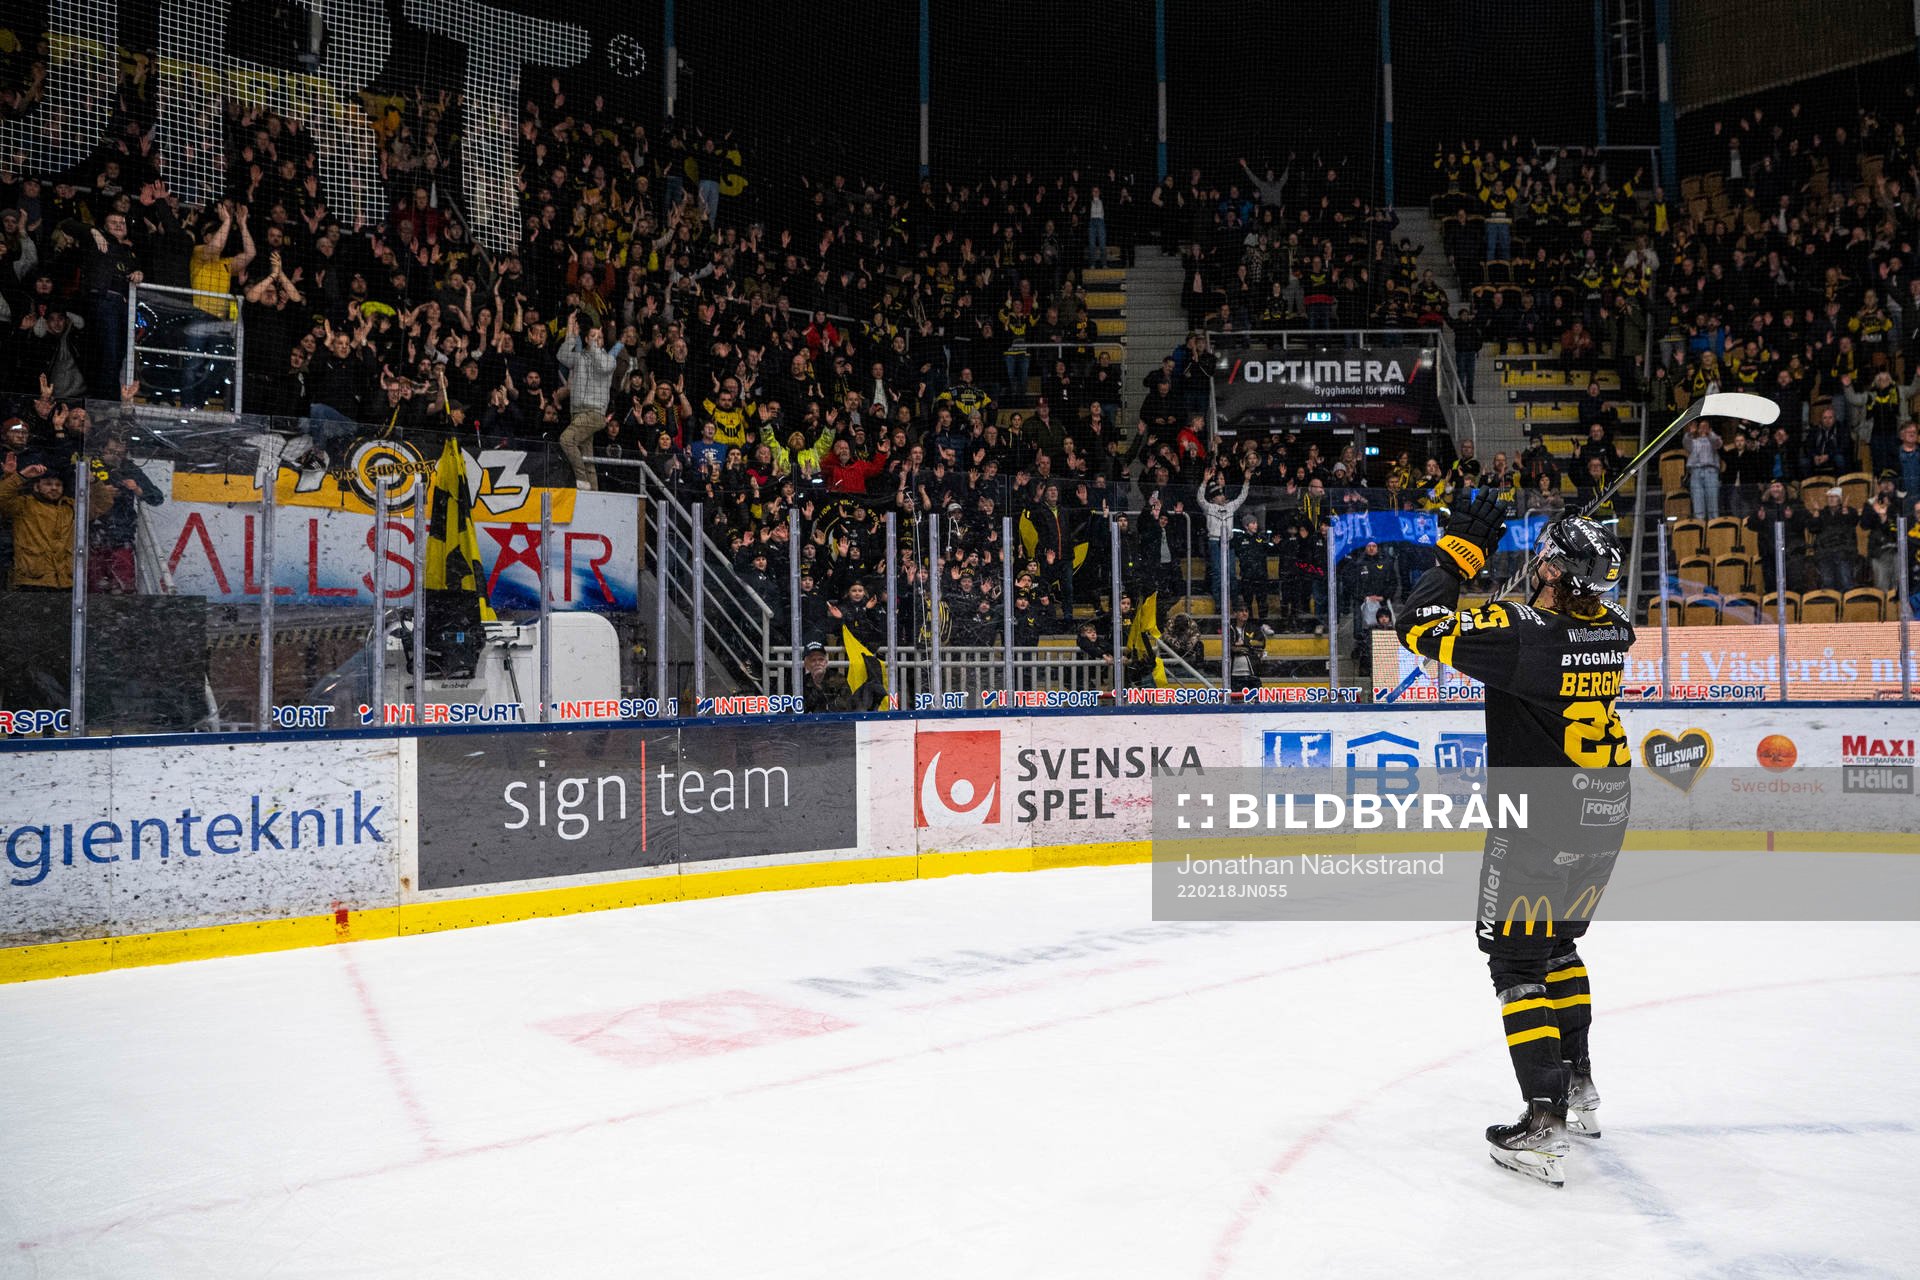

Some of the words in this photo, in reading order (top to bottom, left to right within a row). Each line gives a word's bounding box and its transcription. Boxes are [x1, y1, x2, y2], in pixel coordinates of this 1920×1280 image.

[1244, 360, 1405, 383] OPTIMERA
[1314, 385, 1364, 397] Bygghandel
[1365, 385, 1378, 396] för
[1379, 385, 1406, 397] proffs
[365, 460, 437, 477] SUPPORT
[160, 512, 617, 604] ALLSAR
[1680, 652, 1691, 681] i
[1702, 648, 1858, 682] Västerås
[1127, 687, 1228, 704] INTERSPORT
[1259, 687, 1359, 702] INTERSPORT
[560, 698, 678, 719] INTERSPOT
[1017, 745, 1206, 782] SVENSKA
[1655, 745, 1705, 767] GULSVART
[1731, 778, 1824, 794] Swedbank
[1848, 769, 1909, 789] Hälla
[504, 760, 627, 841] sign
[657, 764, 789, 817] team
[1017, 787, 1117, 824] SPEL
[1491, 836, 1509, 860] Bil
